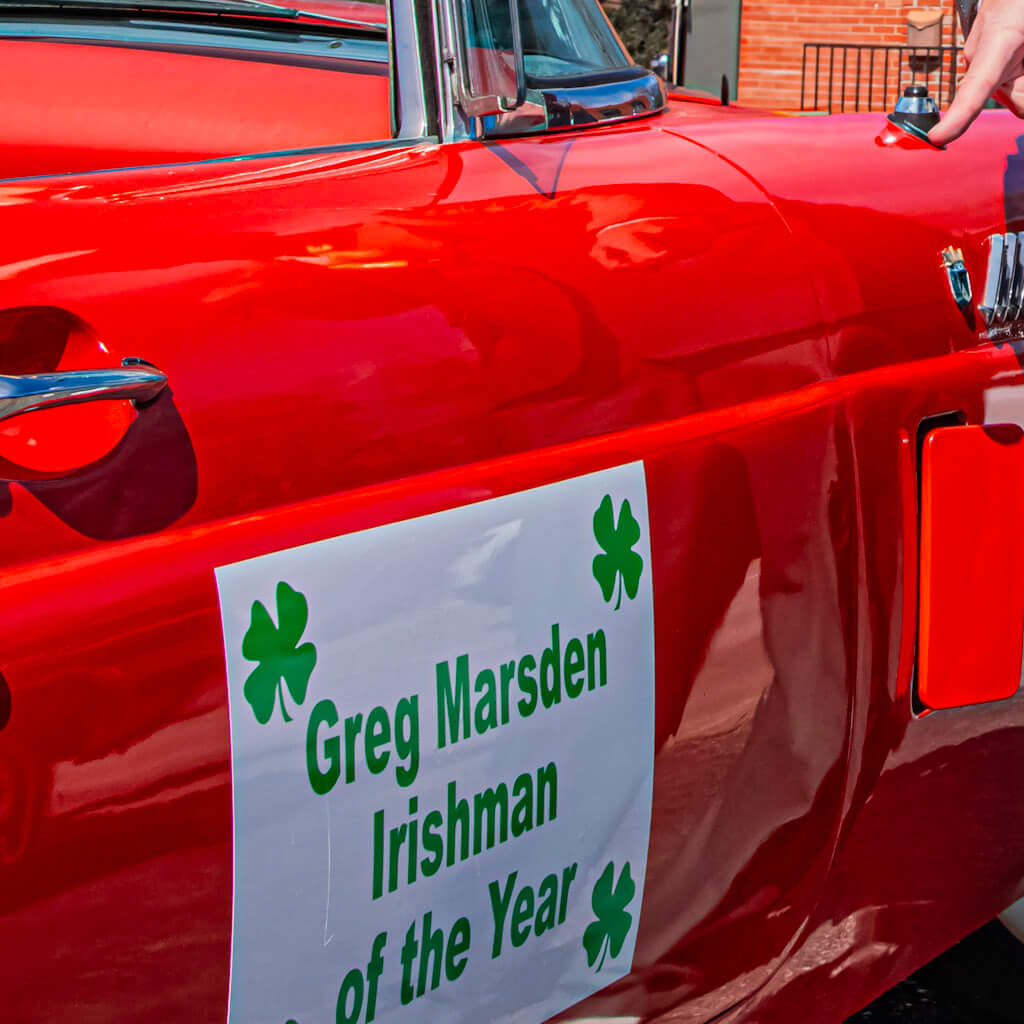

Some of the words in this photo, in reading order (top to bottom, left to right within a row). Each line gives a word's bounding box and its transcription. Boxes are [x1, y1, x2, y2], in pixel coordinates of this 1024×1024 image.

[305, 693, 420, 796] Greg
[435, 623, 608, 750] Marsden
[371, 761, 558, 901] Irishman
[335, 931, 388, 1024] of
[400, 910, 471, 1006] the
[487, 862, 578, 960] Year
